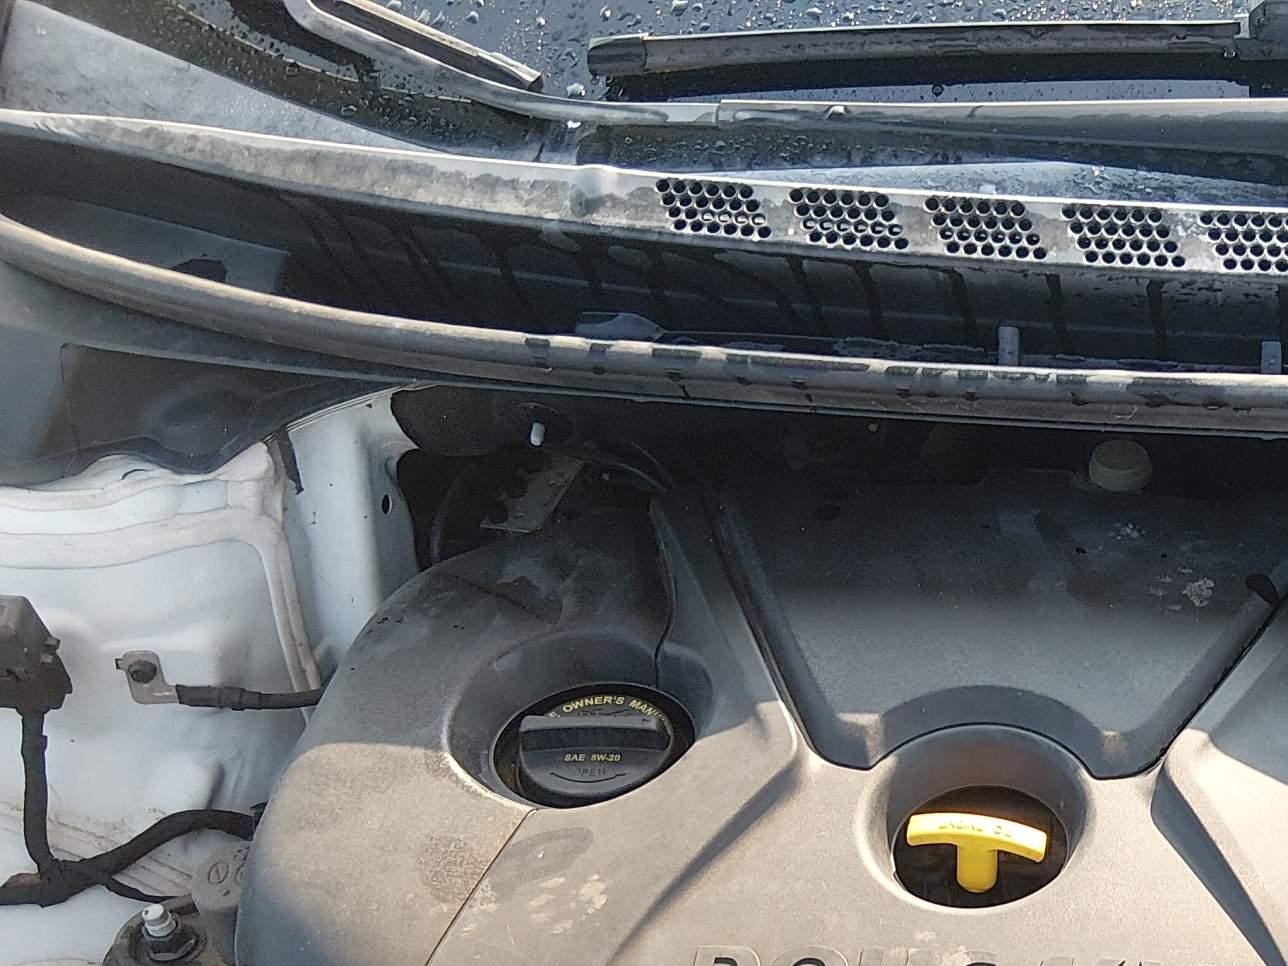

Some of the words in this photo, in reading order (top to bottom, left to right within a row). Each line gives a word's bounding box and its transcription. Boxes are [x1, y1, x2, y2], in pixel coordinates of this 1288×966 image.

[563, 695, 625, 713] OWNER'S
[628, 699, 663, 718] MAN
[563, 753, 585, 762] SAE
[590, 753, 620, 762] 5W-20
